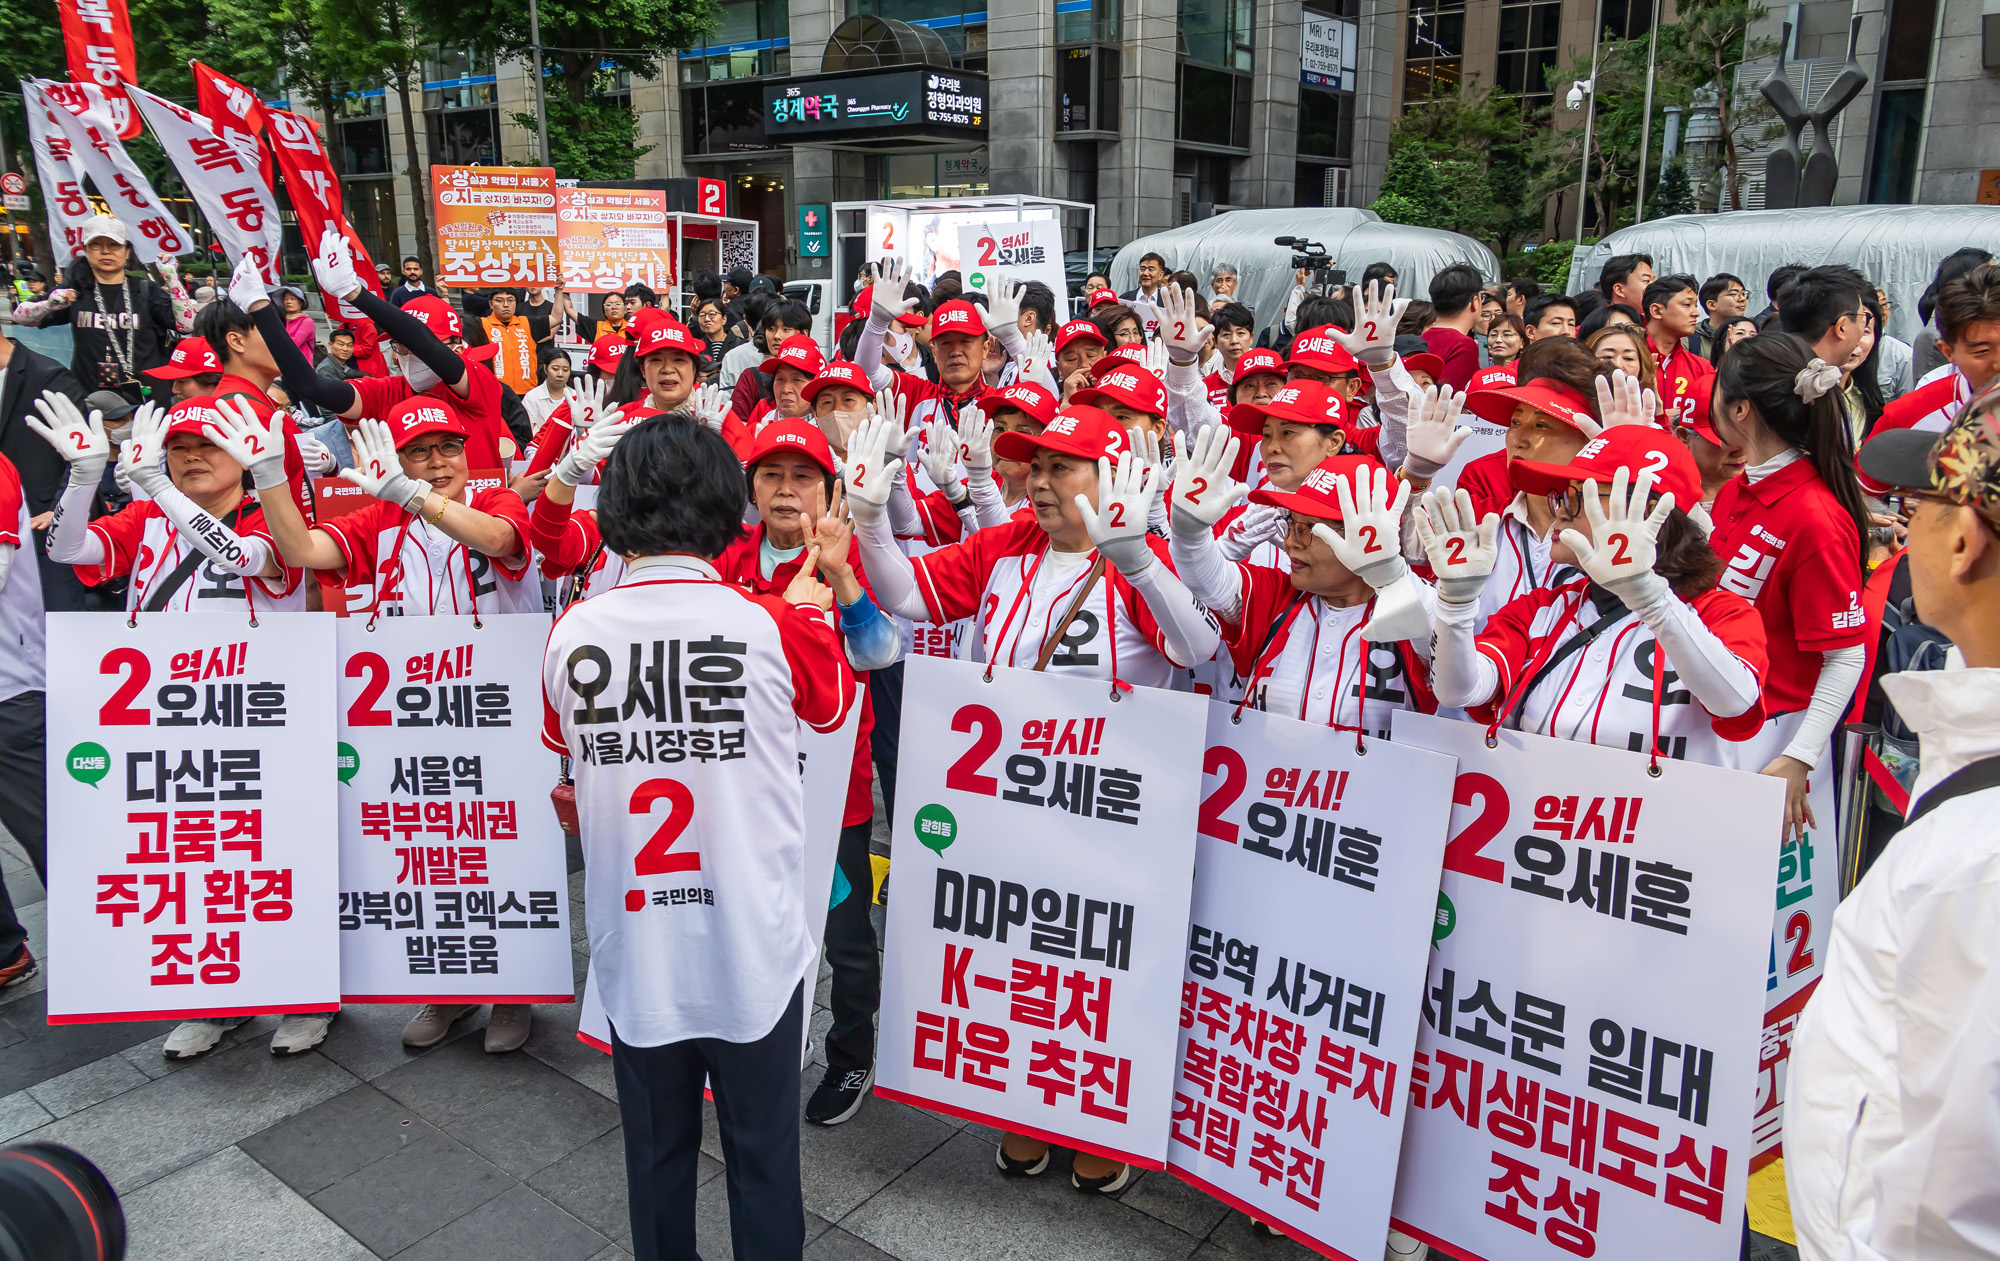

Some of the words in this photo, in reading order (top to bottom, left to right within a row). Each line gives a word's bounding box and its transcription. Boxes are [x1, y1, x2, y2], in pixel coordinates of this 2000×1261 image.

[1309, 22, 1322, 39] MRI
[1327, 28, 1337, 41] CT
[786, 87, 801, 97] 365
[940, 77, 961, 93] 우리본
[773, 94, 839, 123] 청계약국
[847, 98, 857, 106] 365
[871, 104, 891, 112] Pharmacy
[927, 91, 982, 114] 정형외과의원
[928, 111, 969, 124] 02-755-8575
[972, 116, 982, 126] 2F
[944, 158, 978, 172] 청계약국
[452, 169, 488, 187] 상실과
[522, 177, 539, 187] 서울
[454, 187, 482, 204] 지금
[513, 194, 542, 205] 바꾸자!
[634, 197, 651, 206] 서울
[705, 184, 720, 213] 2
[627, 213, 653, 221] 바꾸자!
[883, 221, 894, 250] 2
[1001, 231, 1030, 249] 역시!
[327, 252, 340, 268] 2
[976, 237, 996, 267] 2
[998, 246, 1046, 266] 오세훈
[444, 251, 545, 283] 조상지
[562, 261, 655, 289] 조상지
[77, 311, 140, 330] MERCI
[447, 311, 460, 333] 2
[938, 310, 969, 327] 오세훈
[1065, 324, 1095, 336] 오세훈
[1173, 321, 1186, 341] 2
[1364, 321, 1379, 341] 2
[651, 328, 684, 343] 오세훈
[1296, 337, 1336, 356] 오세훈
[203, 352, 216, 368] 2
[517, 339, 530, 379] 조상지
[589, 347, 597, 360] 2
[901, 344, 908, 355] 2
[1023, 359, 1033, 374] 2
[1244, 355, 1275, 370] 오세훈
[1098, 372, 1139, 392] 오세훈
[1482, 372, 1516, 385] 김길성
[1675, 377, 1688, 395] 2
[1004, 386, 1042, 407] 오세훈
[1155, 388, 1166, 411] 2
[1326, 396, 1341, 419] 2
[402, 408, 448, 430] 오세훈
[584, 407, 594, 422] 2
[1682, 398, 1696, 423] 2
[69, 431, 91, 450] 2
[244, 435, 265, 456] 2
[960, 443, 972, 462] 2
[1105, 431, 1123, 458] 2
[132, 443, 143, 464] 2
[321, 452, 330, 461] 2
[370, 459, 387, 479] 2
[853, 464, 866, 488] 2
[1638, 450, 1670, 485] 2
[334, 486, 362, 496] 국민의힘
[1184, 477, 1208, 505] 2
[1109, 502, 1126, 528] 2
[1359, 525, 1383, 554] 2
[1446, 537, 1467, 565] 2
[1608, 533, 1632, 566] 2
[1760, 530, 1787, 550] 국민의힘
[235, 554, 250, 569] 2
[1849, 591, 1859, 610] 2
[1832, 606, 1866, 629] 김길성
[170, 642, 248, 683] 역시!
[405, 644, 474, 684] 역시!
[99, 647, 152, 727] 2
[344, 651, 394, 728] 2
[566, 635, 748, 727] 오세훈
[156, 681, 287, 728] 오세훈
[396, 682, 513, 728] 오세훈
[580, 728, 747, 766] 서울시장후보
[1020, 716, 1106, 757] 역시!
[72, 755, 106, 770] 다산동
[945, 703, 1003, 798] 2
[126, 748, 263, 803] 다산로
[389, 755, 484, 796] 서울역
[1002, 754, 1143, 827] 오세훈
[1200, 745, 1248, 845] 2
[1263, 766, 1350, 812] 역시!
[361, 799, 519, 842] 북부역세권
[629, 777, 702, 877] 2
[921, 818, 952, 840] 광희동
[1443, 771, 1511, 885] 2
[1533, 795, 1643, 844] 역시!
[126, 808, 264, 865] 고품격
[1242, 801, 1383, 893] 오세훈
[396, 846, 490, 887] 개발로
[651, 887, 715, 907] 국민의힘
[1511, 834, 1693, 936] 오세훈
[96, 872, 187, 929] 주거
[203, 868, 294, 925] 환경
[338, 890, 423, 932] 강북의
[434, 890, 561, 931] 코엑스로
[932, 867, 1135, 972] DDP일대
[405, 934, 500, 976] 발돋움
[1785, 910, 1815, 978] 2
[149, 931, 242, 988] 조성
[940, 943, 1113, 1044] K-컬처
[1267, 956, 1387, 1048] 사거리
[1423, 964, 1566, 1077] 서소문
[1589, 1018, 1714, 1127] 일대
[912, 1010, 1011, 1094] 타운
[1026, 1039, 1133, 1125] 추진
[1314, 1035, 1399, 1119] 부지
[1183, 1038, 1329, 1150] 복합청사
[1171, 1090, 1242, 1170] 건립
[1249, 1133, 1326, 1213] 추진
[1485, 1150, 1601, 1260] 조성
